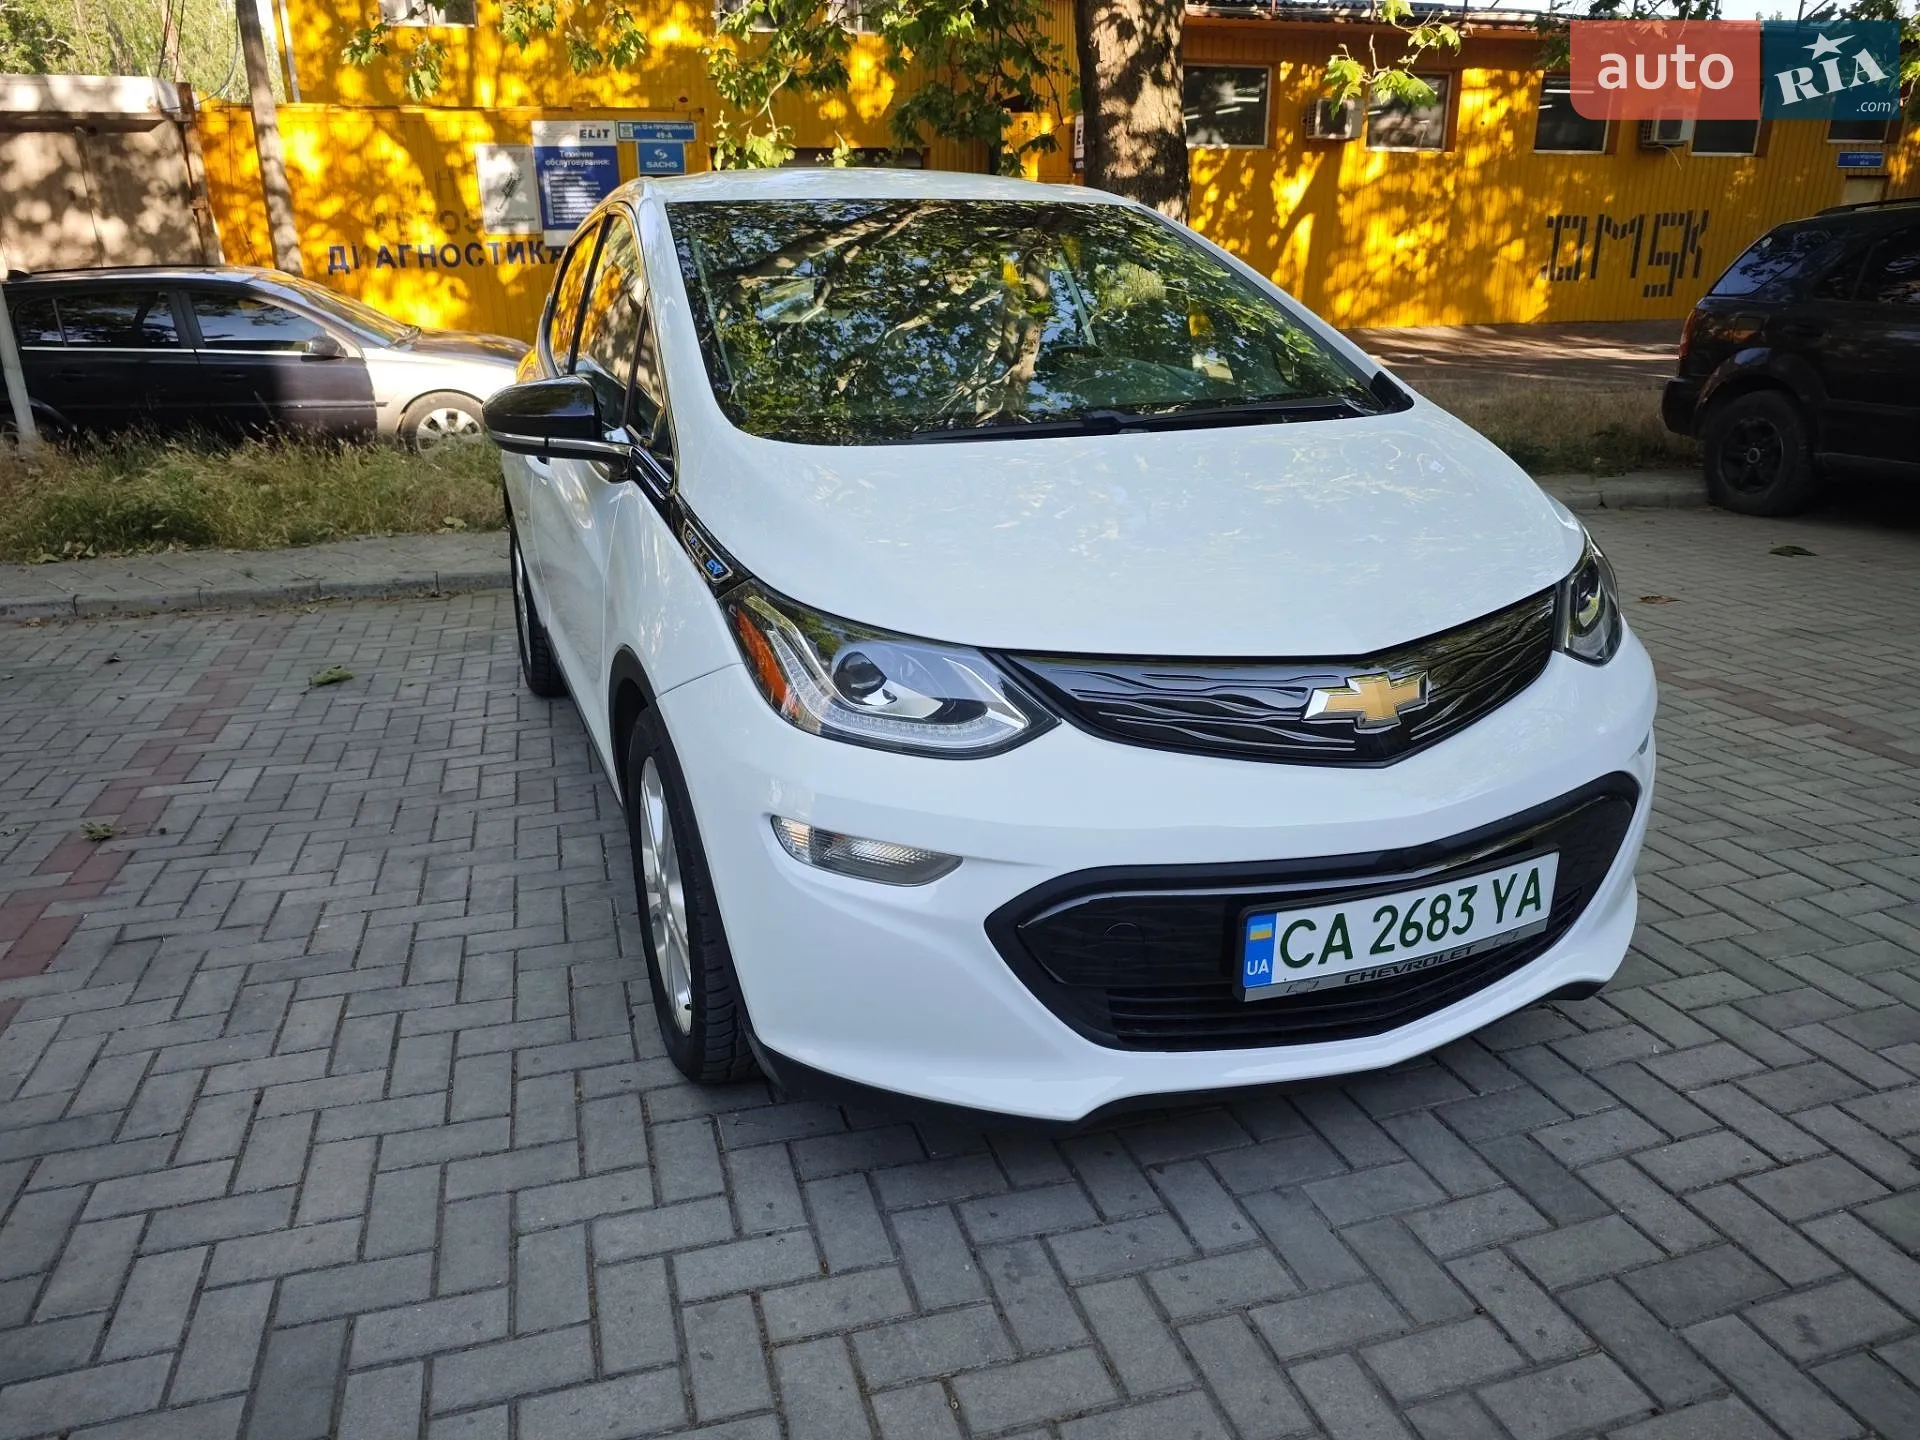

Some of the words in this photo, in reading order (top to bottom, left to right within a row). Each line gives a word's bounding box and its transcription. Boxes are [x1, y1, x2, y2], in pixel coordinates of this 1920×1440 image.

[645, 161, 679, 169] SACHS
[1279, 912, 1354, 969] CA
[1369, 884, 1479, 955] 2683
[1492, 867, 1542, 925] YA
[1246, 958, 1270, 976] UA
[1344, 945, 1475, 984] CHEVROLET
